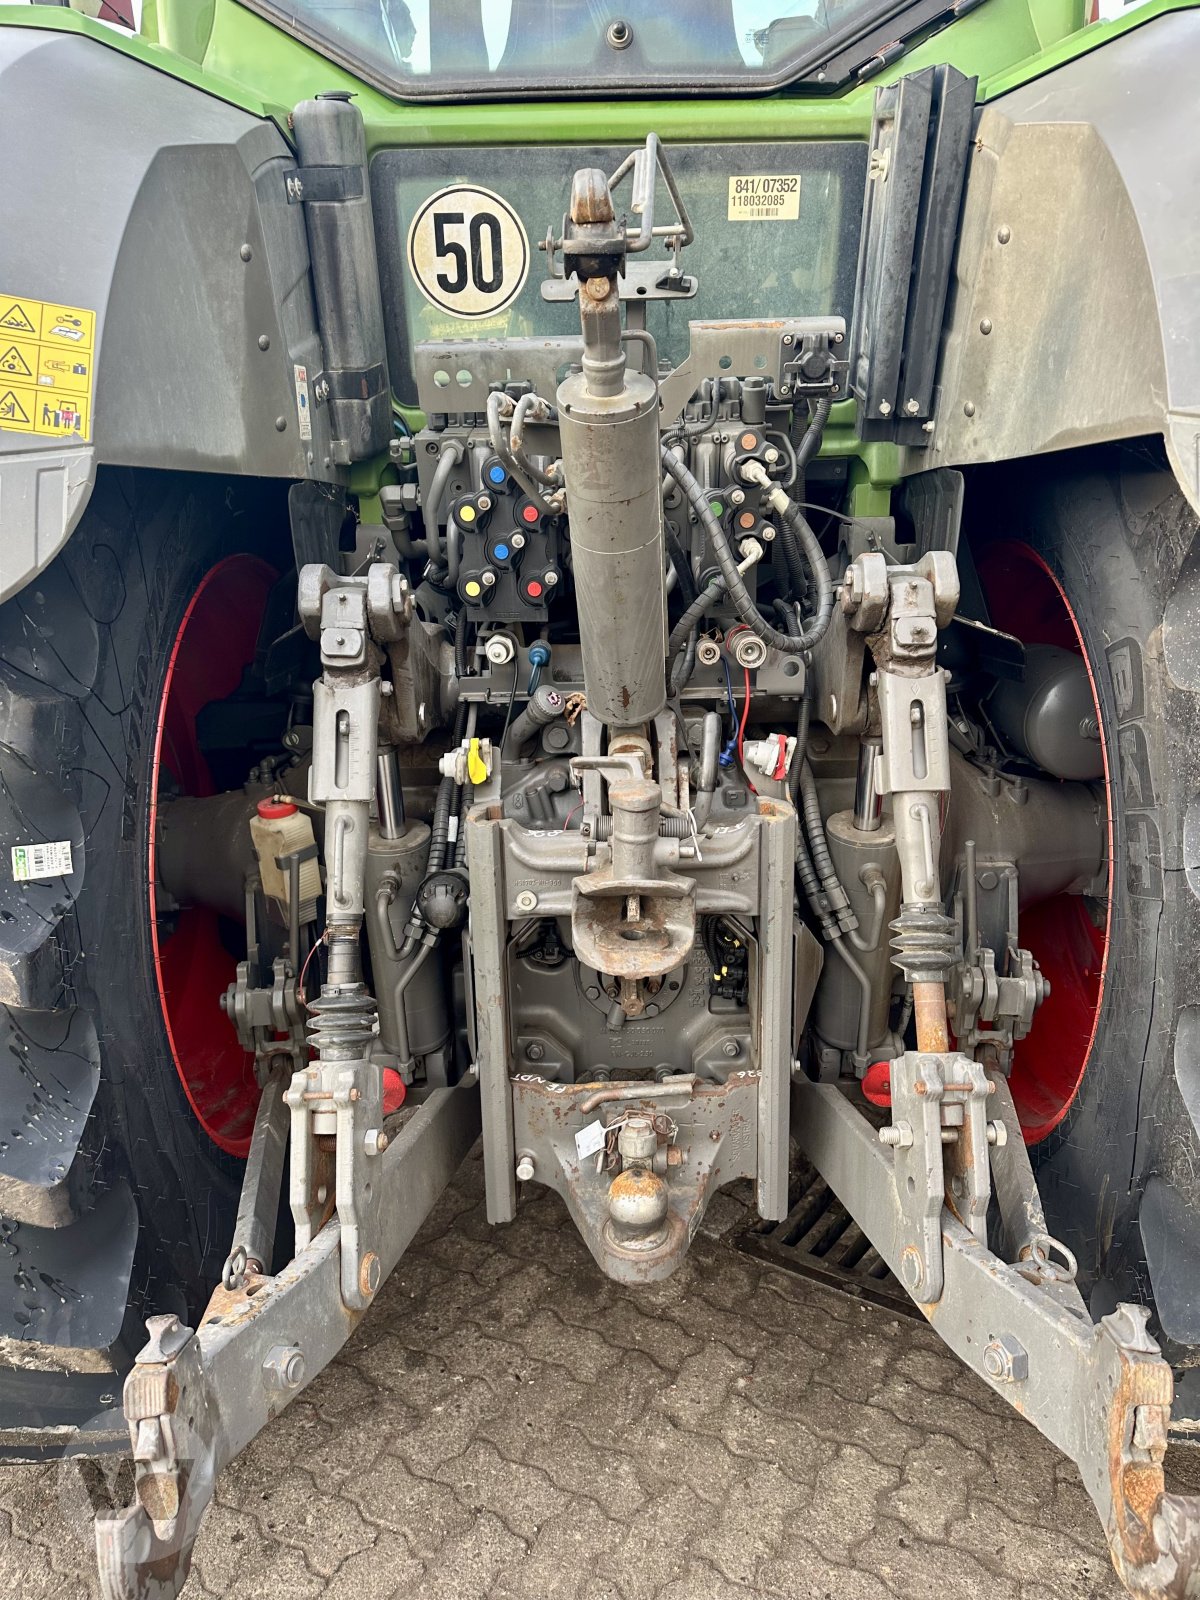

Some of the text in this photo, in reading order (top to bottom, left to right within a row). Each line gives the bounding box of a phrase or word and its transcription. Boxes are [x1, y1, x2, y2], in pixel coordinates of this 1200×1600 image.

[731, 194, 785, 206] 118032085
[433, 212, 504, 294] 50
[1107, 646, 1152, 889] BKT
[509, 1073, 567, 1093] FENDT
